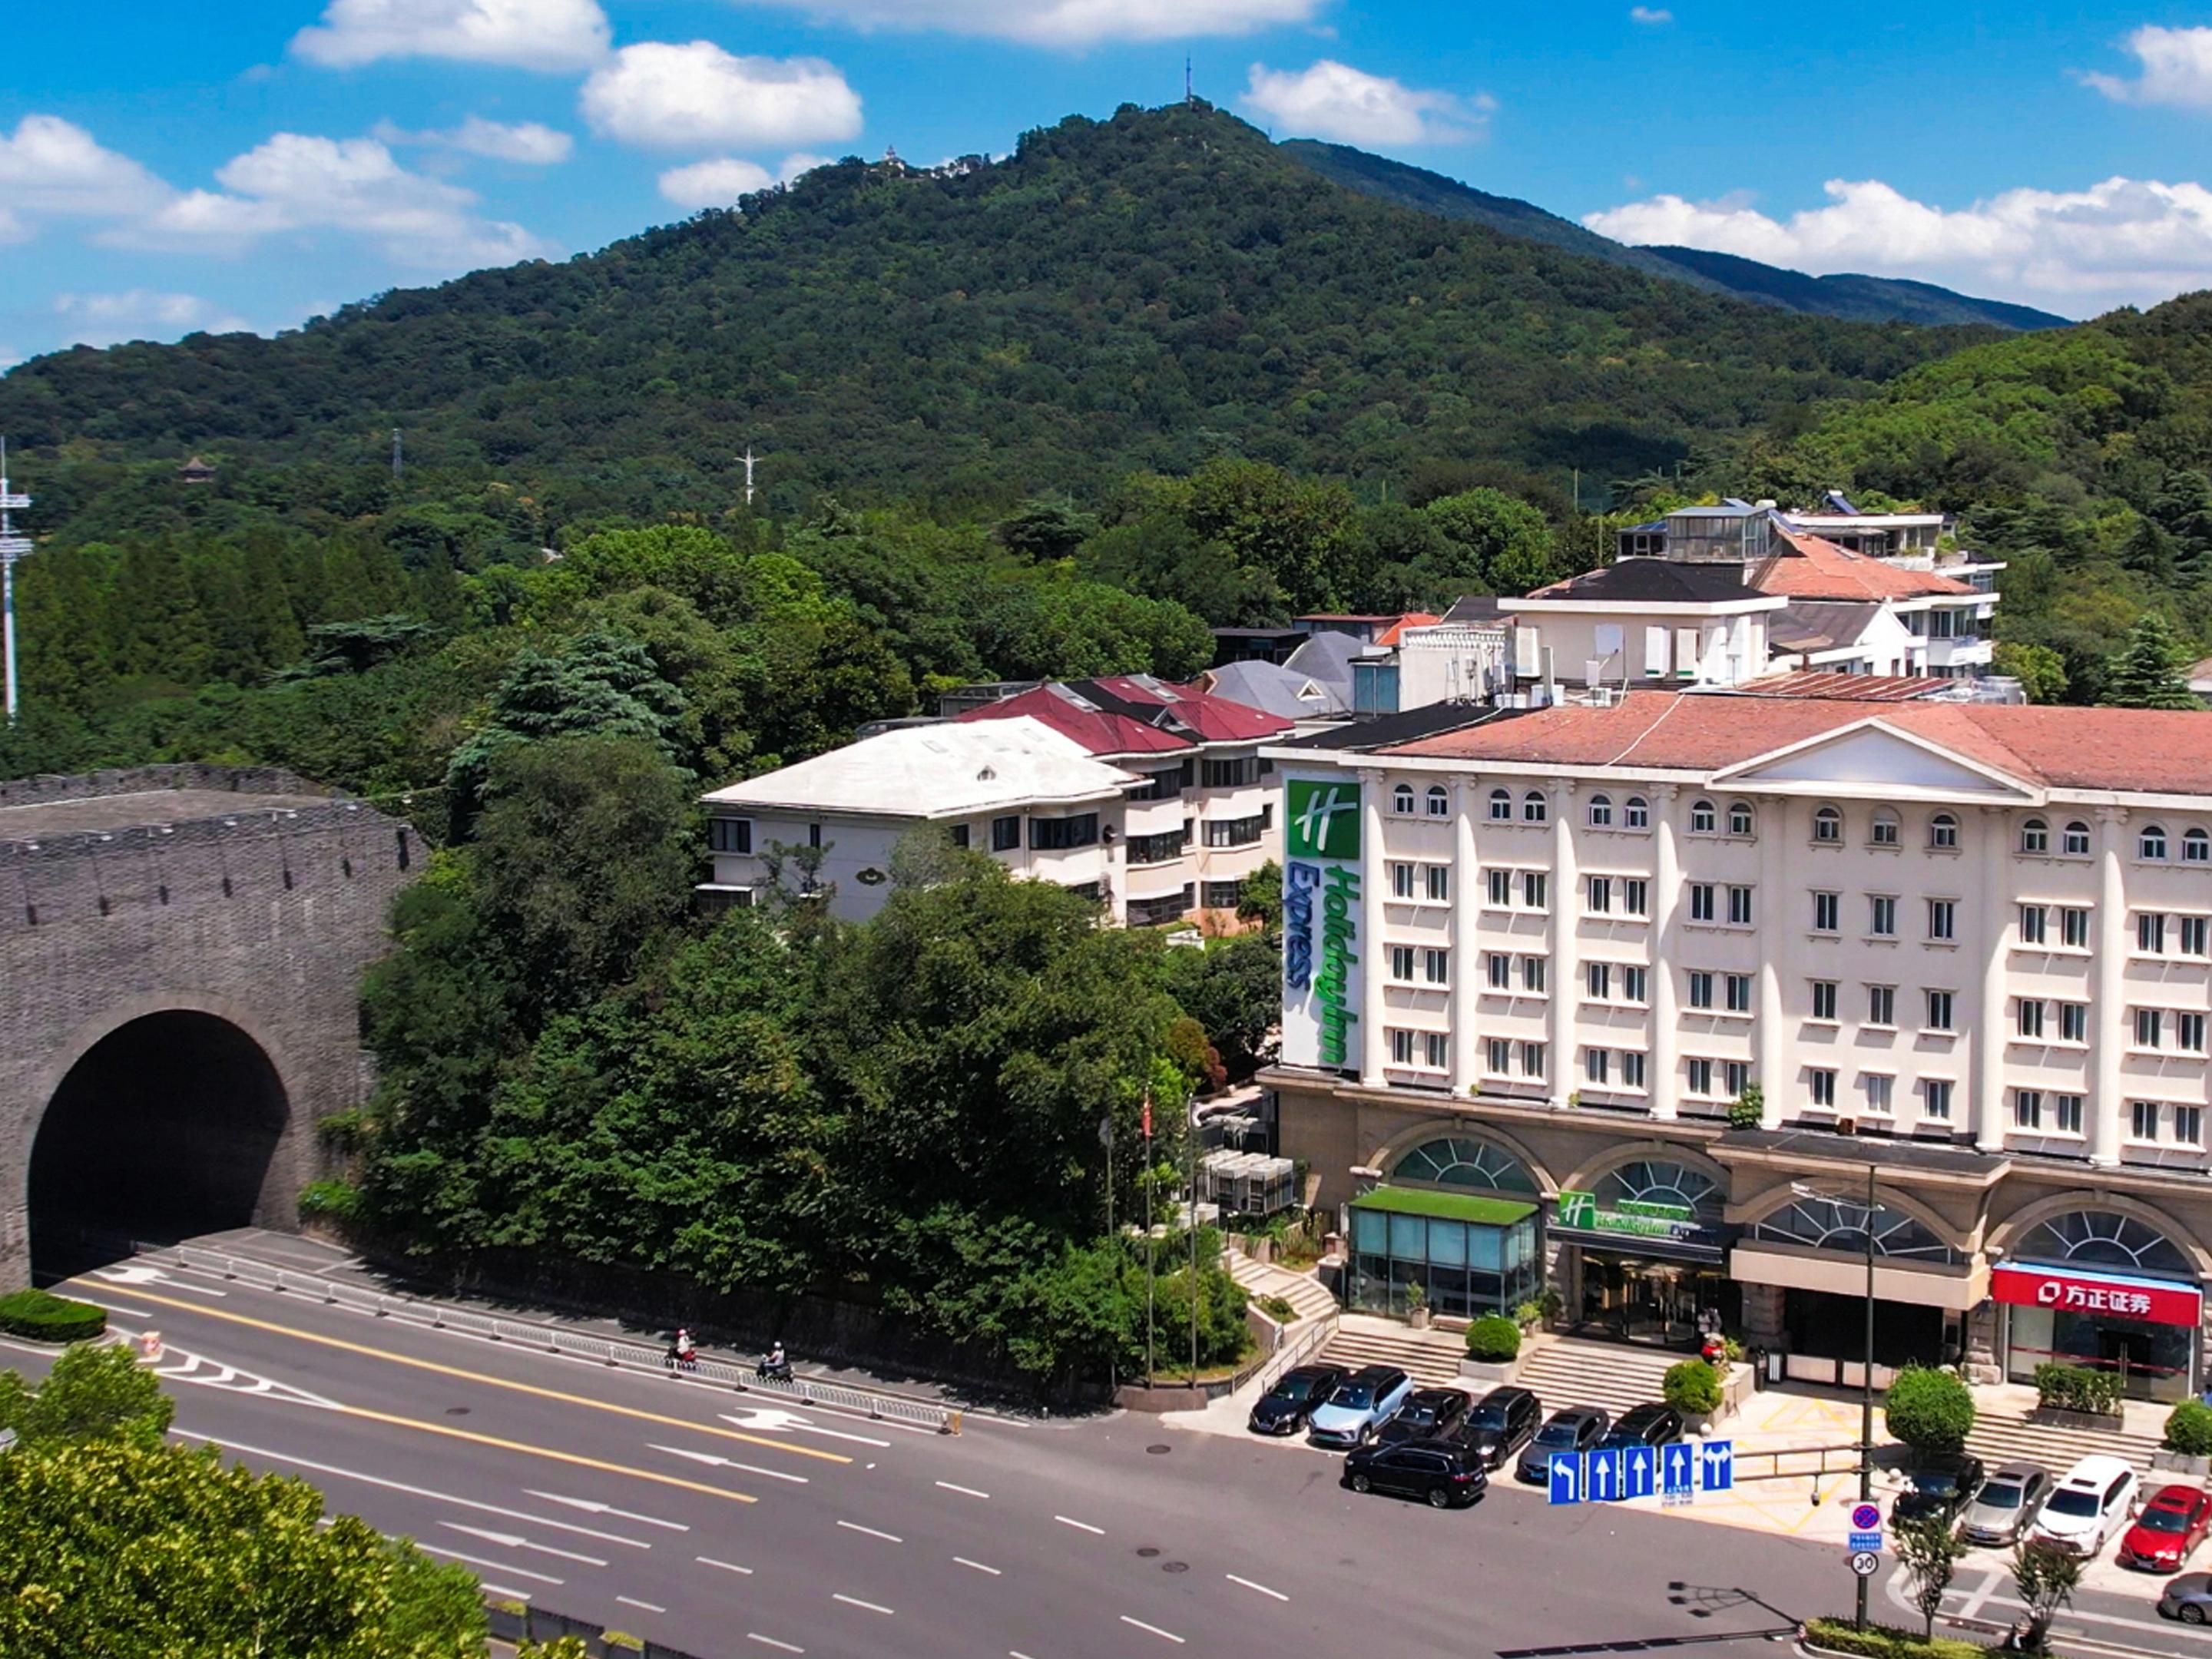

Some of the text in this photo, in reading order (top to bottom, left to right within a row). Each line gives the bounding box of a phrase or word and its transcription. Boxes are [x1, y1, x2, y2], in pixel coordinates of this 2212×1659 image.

[1283, 861, 1320, 991] Express
[1314, 865, 1360, 1064] Holiday Inn
[2065, 1285, 2151, 1314] 方正证券
[1856, 1557, 1873, 1570] 30
